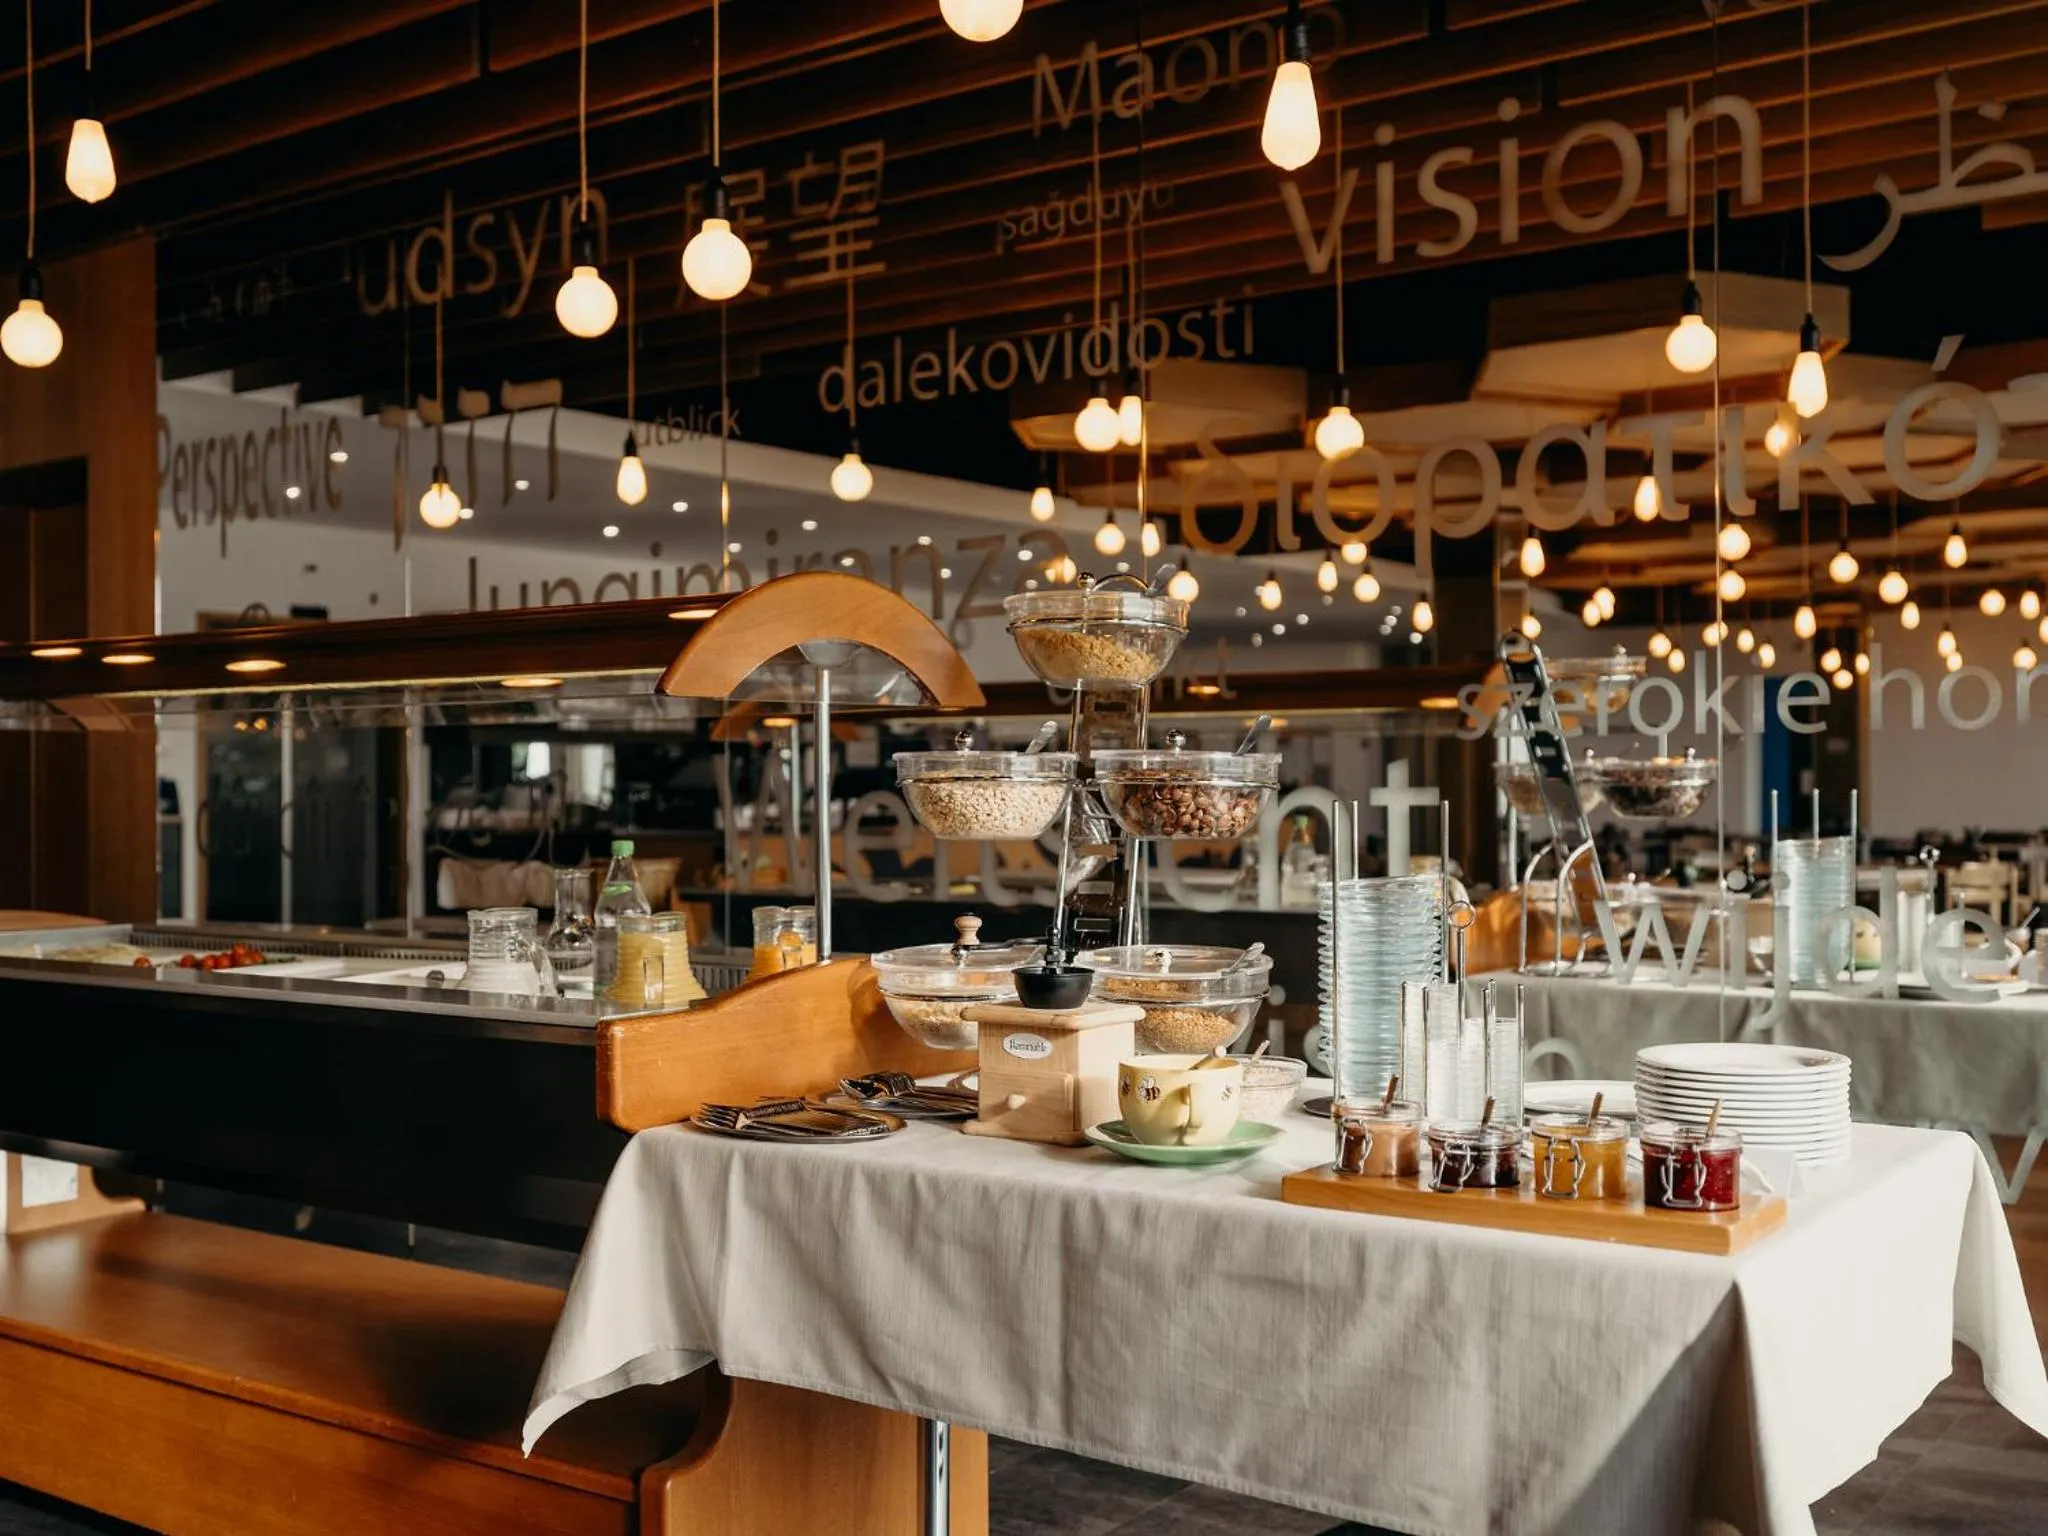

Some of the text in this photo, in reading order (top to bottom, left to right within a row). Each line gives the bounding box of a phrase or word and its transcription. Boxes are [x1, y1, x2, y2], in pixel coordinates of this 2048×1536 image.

[1280, 94, 1763, 274] vision
[818, 284, 1255, 414] dalekovidosti
[1179, 333, 2048, 579] διορατικό
[1454, 648, 1832, 741] szerokie
[1593, 866, 2007, 1030] wijde
